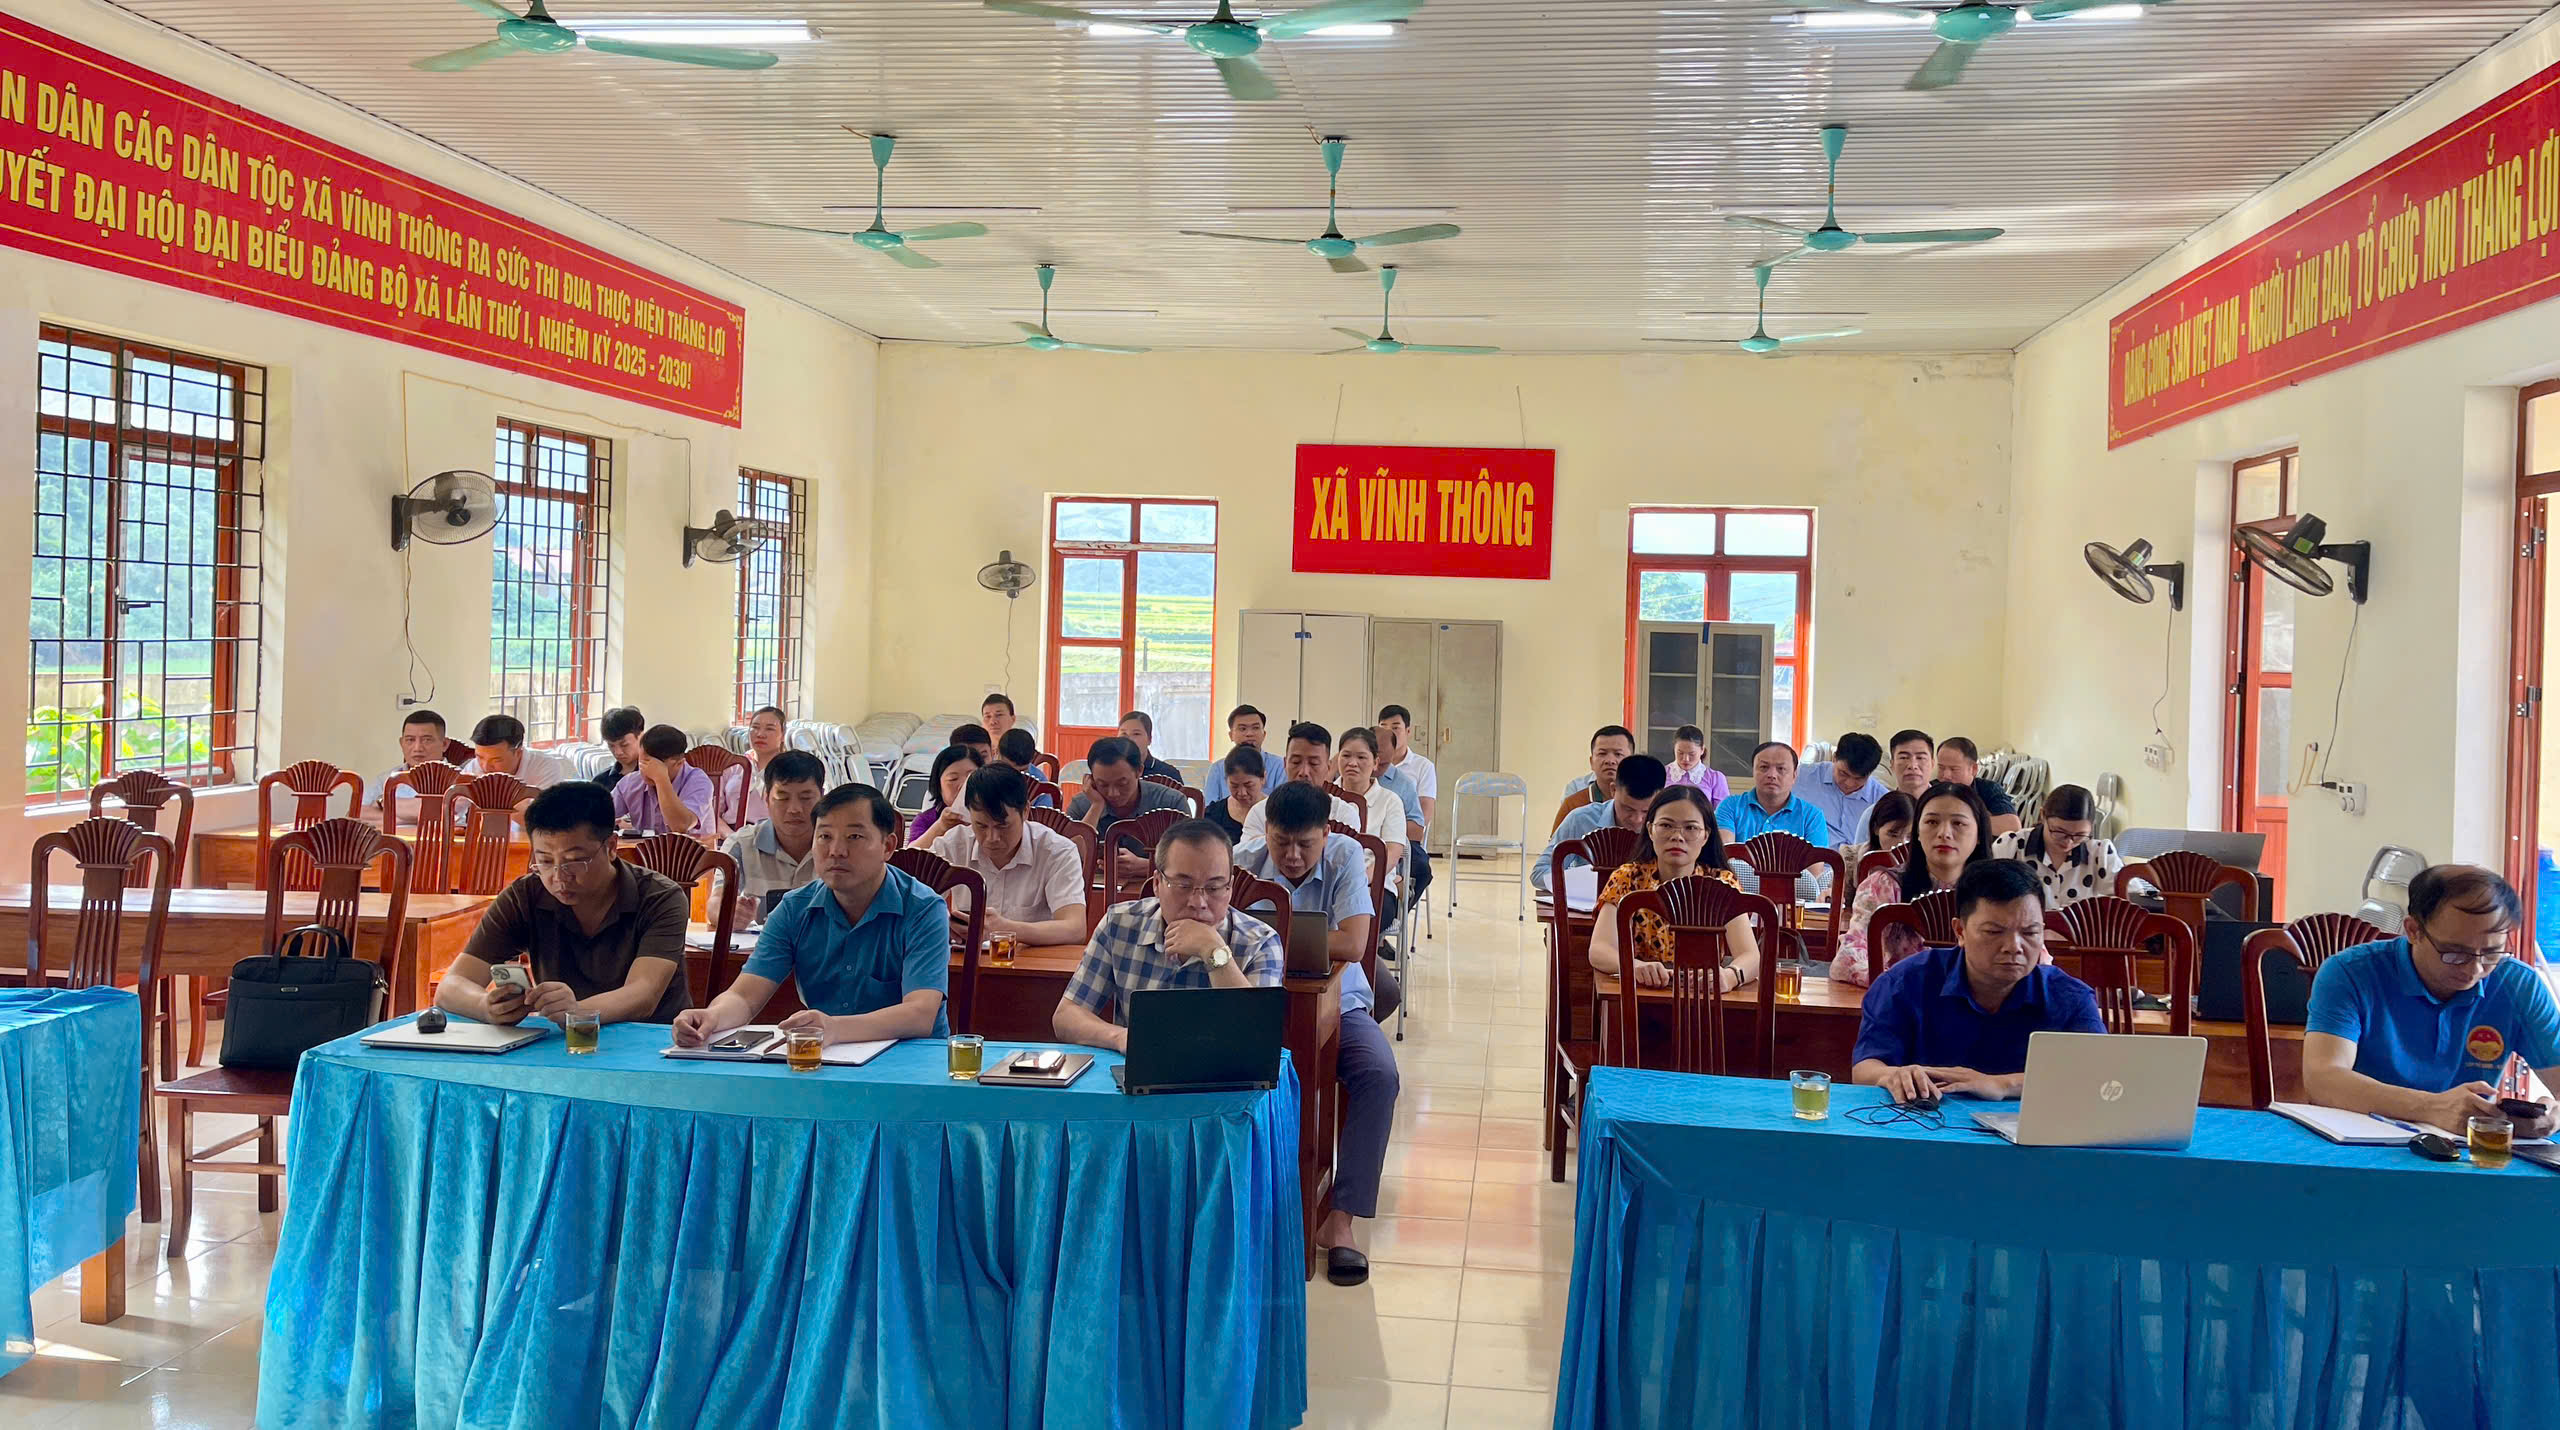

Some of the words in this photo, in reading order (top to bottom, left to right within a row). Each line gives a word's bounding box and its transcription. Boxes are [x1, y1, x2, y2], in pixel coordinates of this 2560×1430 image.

[37, 82, 104, 149] DÂN
[114, 110, 173, 171] CÁC
[182, 133, 239, 194] DÂN
[247, 155, 295, 214] TỘC
[302, 176, 334, 225] XÃ
[340, 187, 391, 245] VĨNH
[398, 215, 462, 267] THÔNG
[467, 237, 491, 278] RA
[496, 245, 530, 290] SỨC
[535, 262, 559, 300] THI
[563, 272, 593, 312] ĐUA
[596, 282, 631, 328] THỰC
[634, 297, 665, 340] HIỆN
[667, 305, 706, 352] THẮNG
[708, 326, 726, 357] LỢI
[74, 172, 127, 237] ĐẠI
[136, 188, 185, 254] HỘI
[193, 209, 239, 269] ĐẠI
[248, 218, 305, 280] BIỂU
[312, 238, 374, 300] ĐẢNG
[380, 264, 408, 317] BỘ
[414, 275, 441, 320] XÃ
[446, 279, 482, 331] LẦN
[487, 299, 522, 341] THỨ
[524, 311, 534, 350] I,
[538, 317, 589, 364] NHIỆM
[592, 330, 611, 367] KỲ
[613, 341, 647, 378] 2025
[658, 353, 692, 390] 2030!
[2172, 301, 2191, 386] SẢN
[2193, 297, 2214, 388] VIỆT
[2214, 294, 2240, 368] NAM
[2248, 257, 2285, 354] NGƯỜI
[2286, 250, 2320, 339] LÃNH
[2321, 240, 2352, 337] ĐẠO,
[2357, 194, 2377, 310] TỔ
[2378, 193, 2420, 302] CHỨC
[2423, 187, 2458, 296] MỌI
[2462, 133, 2523, 268] THẮNG
[2527, 128, 2560, 257] LỢI
[1309, 466, 1349, 540] XÃ
[1359, 466, 1427, 543] VĨNH
[1437, 467, 1534, 547] THÔNG
[2100, 1080, 2124, 1101] hp
